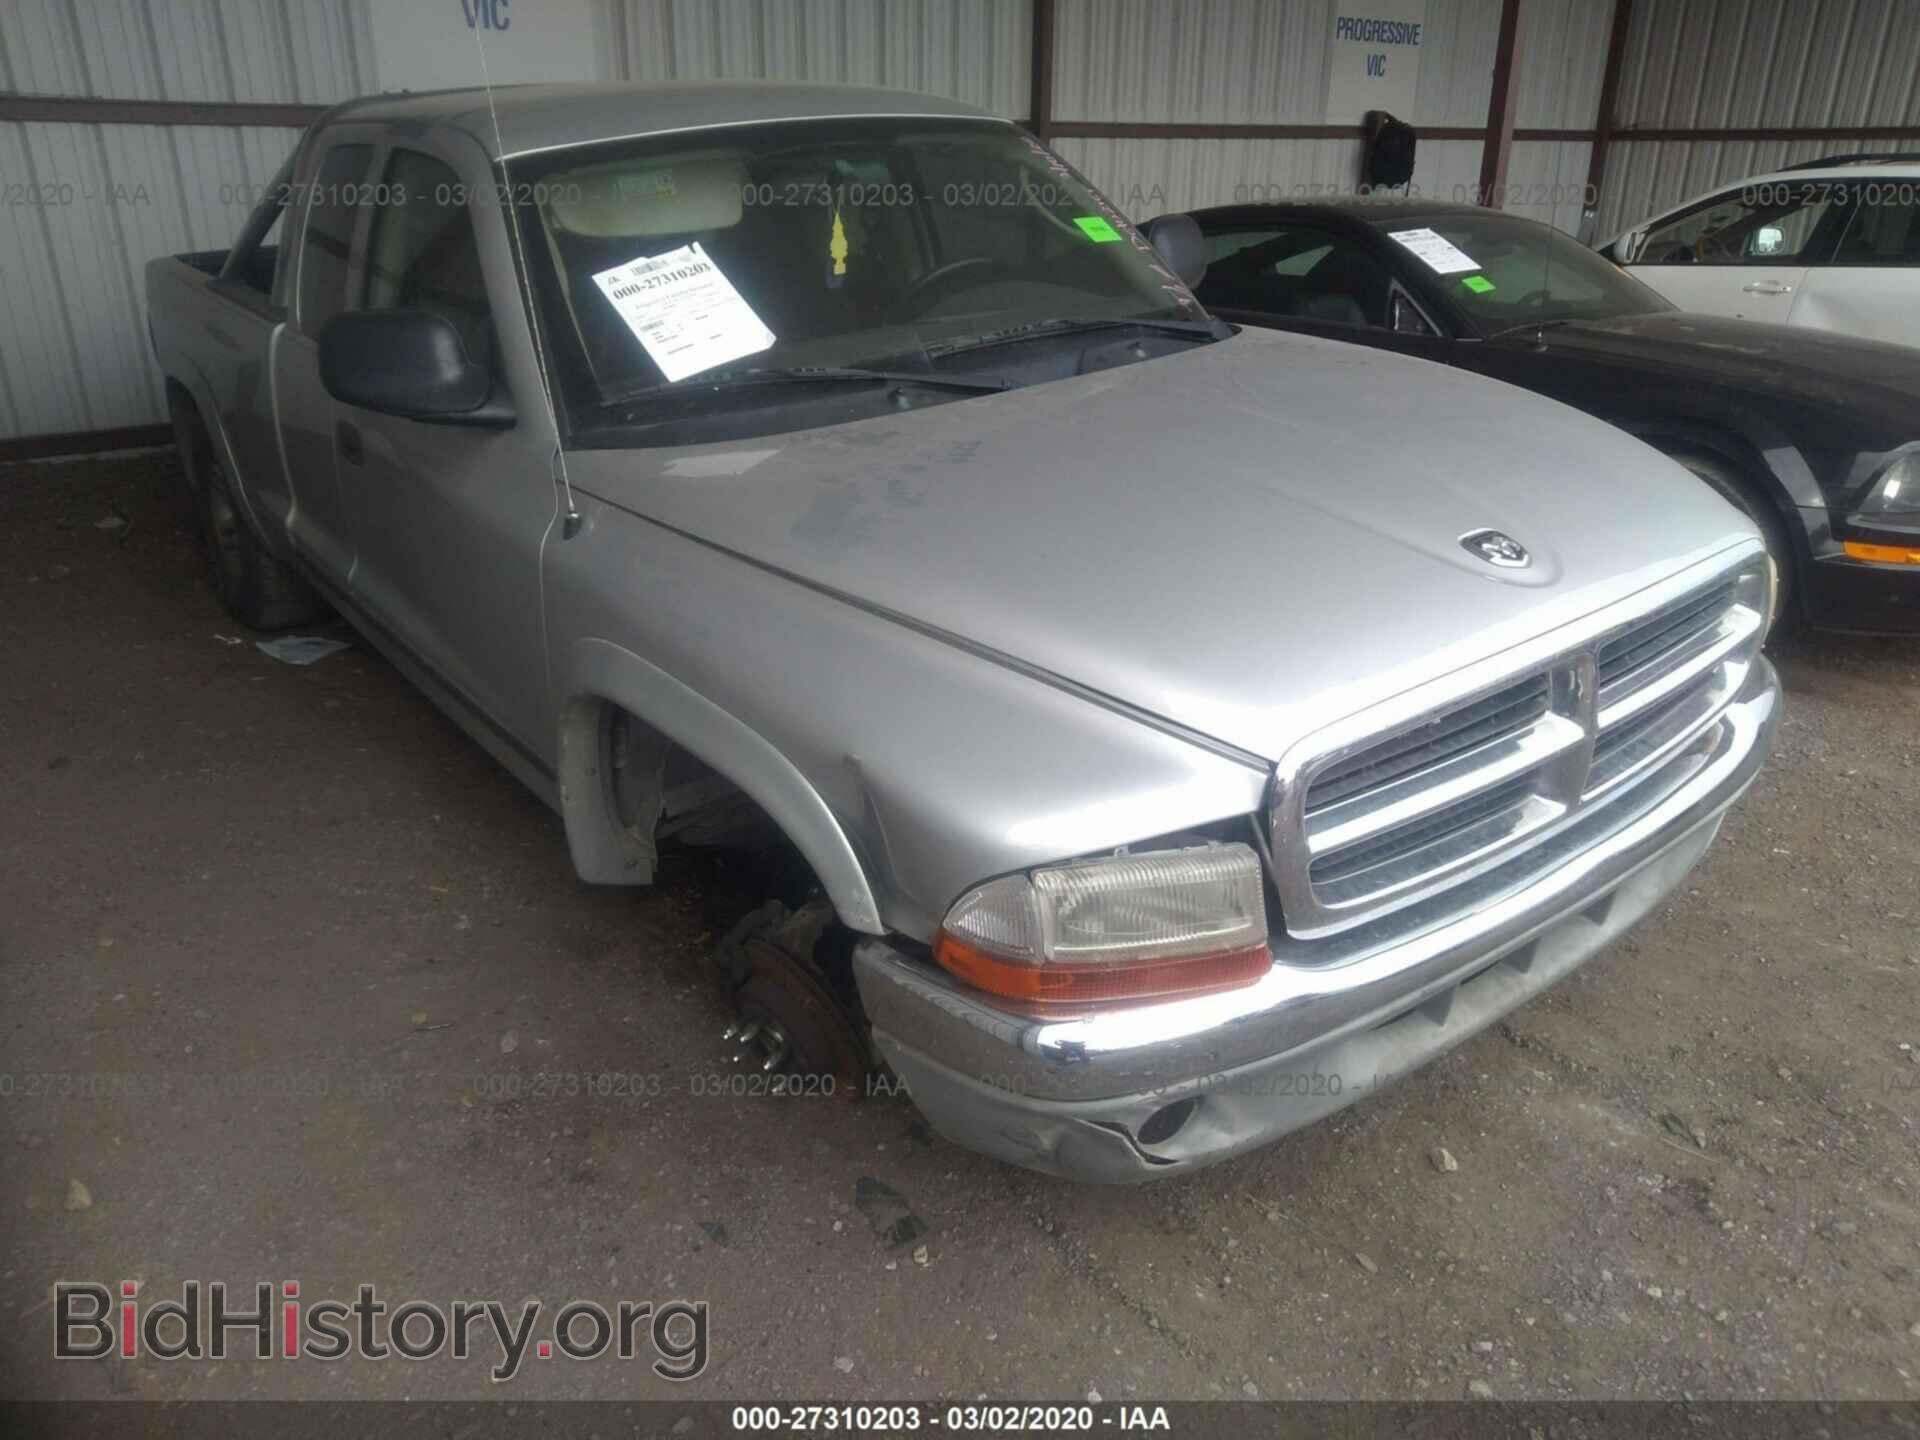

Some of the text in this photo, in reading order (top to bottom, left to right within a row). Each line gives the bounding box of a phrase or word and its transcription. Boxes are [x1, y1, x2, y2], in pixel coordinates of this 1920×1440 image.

[460, 0, 510, 30] VIC
[1336, 16, 1421, 45] PROGRESSIVE
[1367, 53, 1386, 76] VIC
[613, 261, 711, 301] 000-27310203
